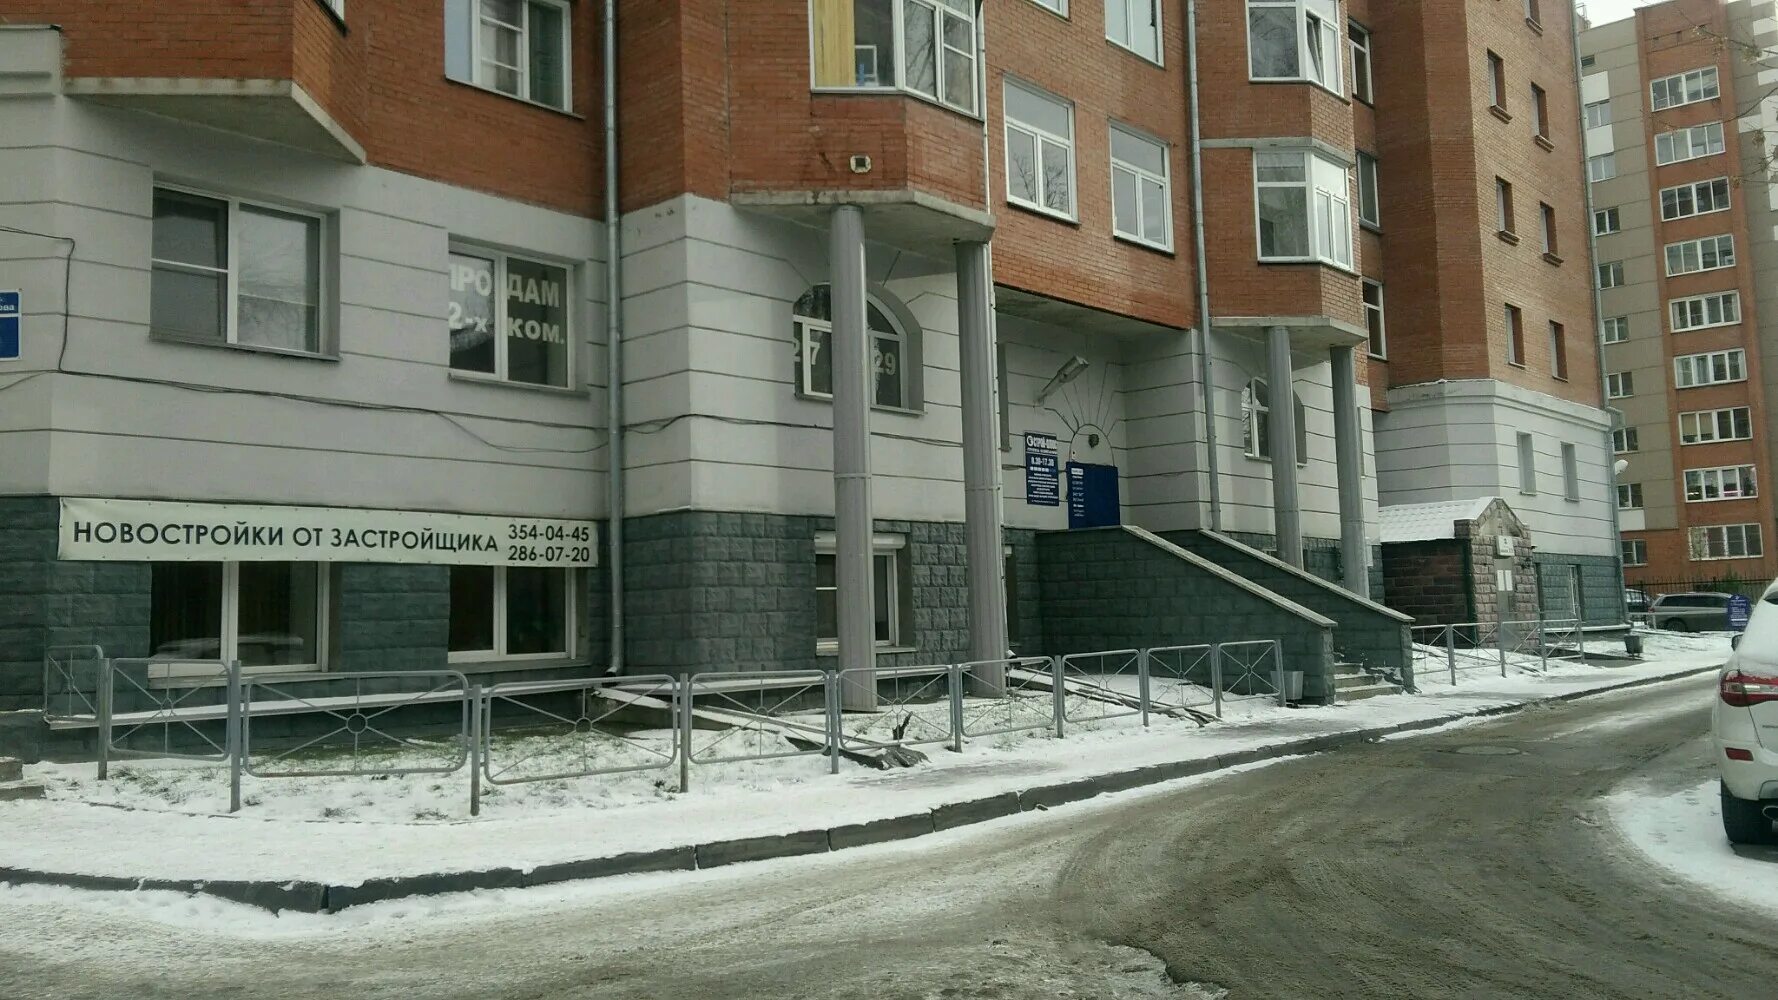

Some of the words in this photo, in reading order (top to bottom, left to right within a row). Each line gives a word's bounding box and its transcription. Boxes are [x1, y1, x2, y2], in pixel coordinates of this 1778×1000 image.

[73, 520, 284, 546] НОВОСТРОЙКИ
[293, 527, 323, 547] ОТ
[330, 527, 499, 553] ЗАСТРОЙЩИКА
[508, 523, 590, 543] 354-04-45
[508, 544, 590, 563] 286-07-20
